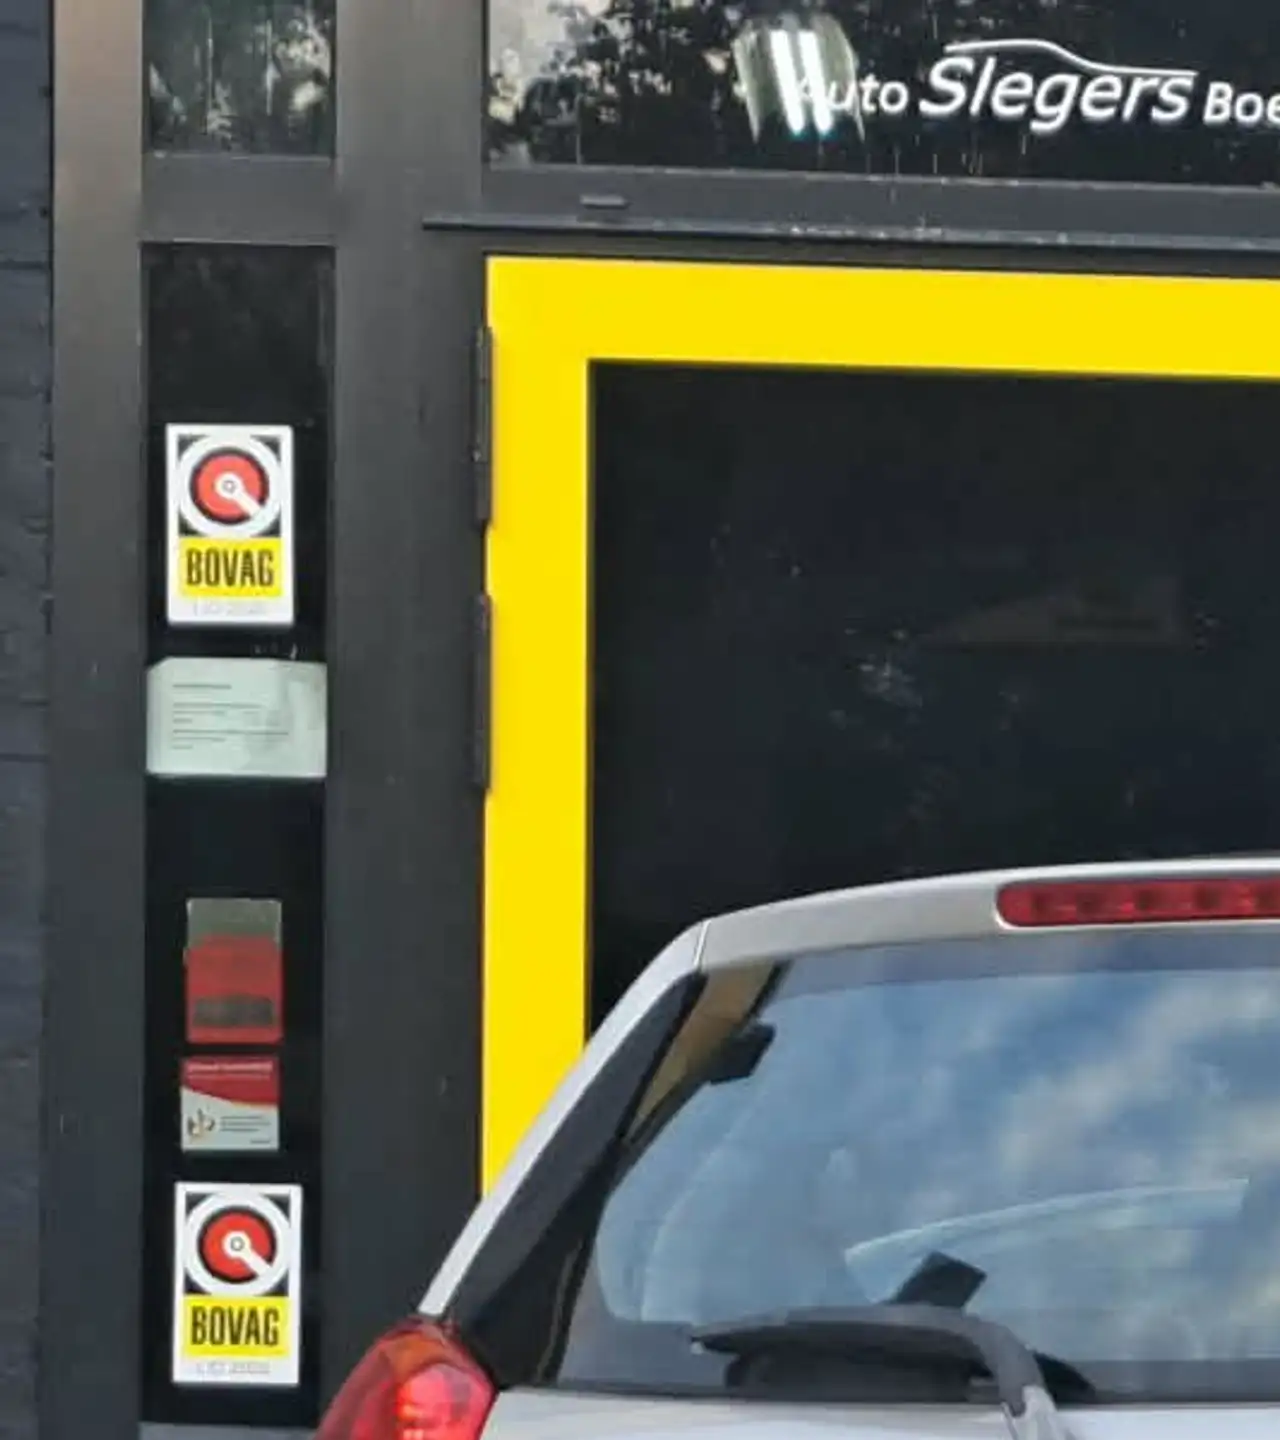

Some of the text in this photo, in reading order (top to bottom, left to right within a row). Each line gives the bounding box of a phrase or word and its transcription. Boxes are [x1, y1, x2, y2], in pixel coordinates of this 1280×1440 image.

[918, 57, 1191, 131] Slegers
[186, 547, 274, 587] BOVAG
[191, 1305, 279, 1346] BOVAG
